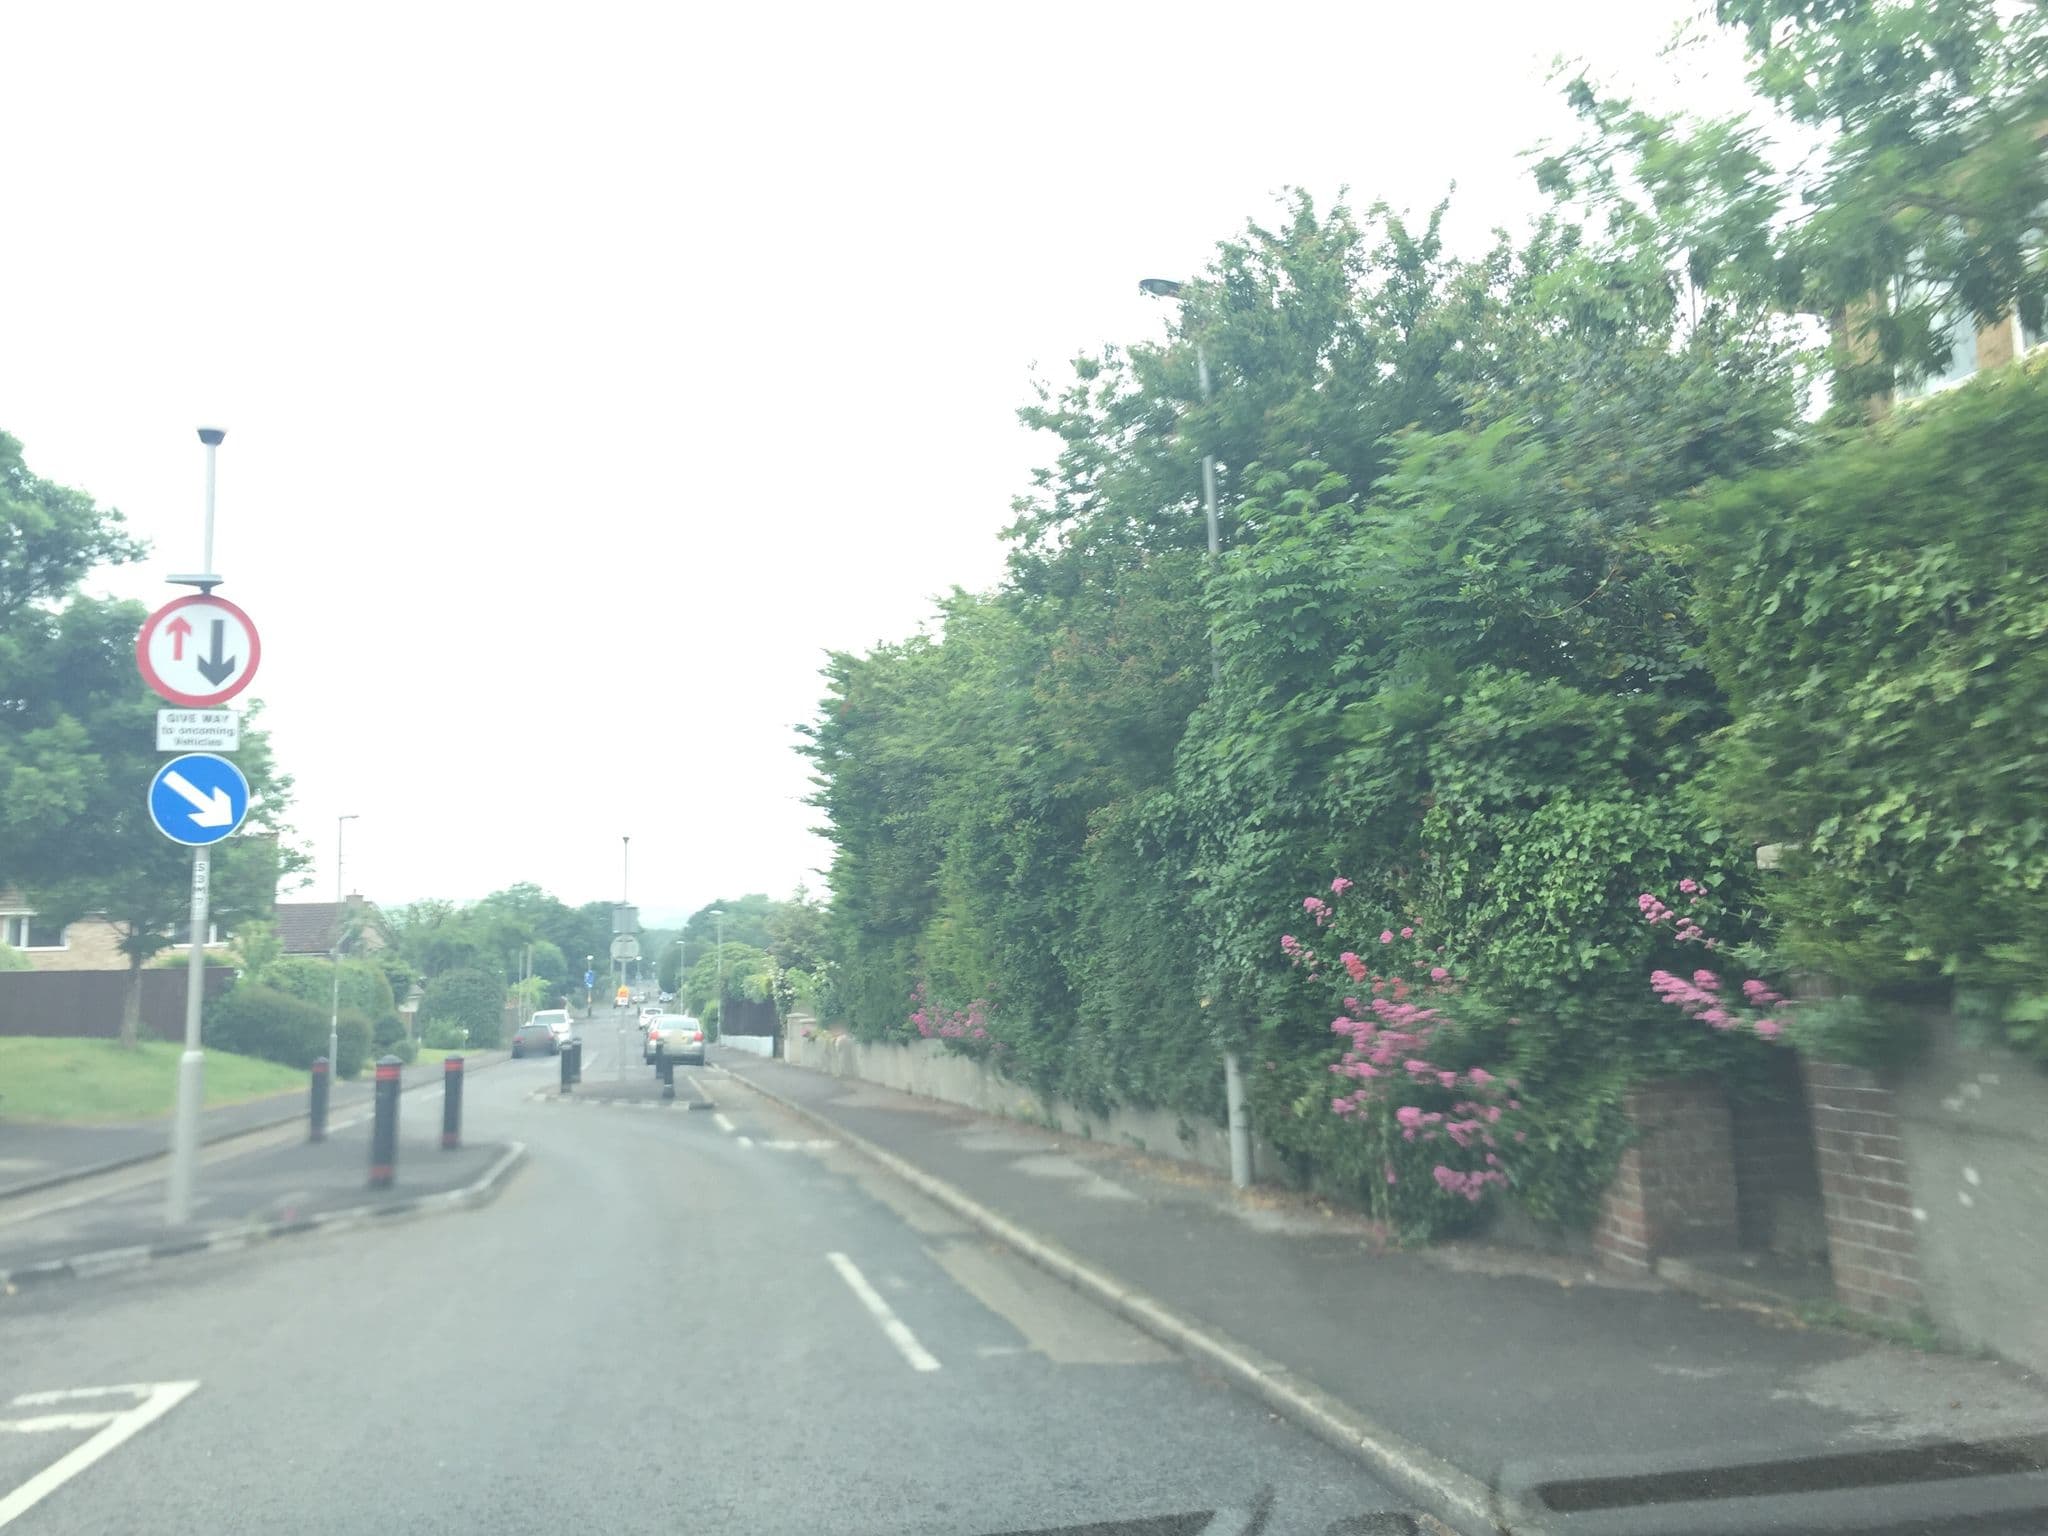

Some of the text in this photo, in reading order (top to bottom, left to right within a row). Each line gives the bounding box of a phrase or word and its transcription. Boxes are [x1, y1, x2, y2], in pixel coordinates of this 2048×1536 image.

[166, 713, 229, 723] GIVE WAY
[162, 727, 235, 737] to oncoming
